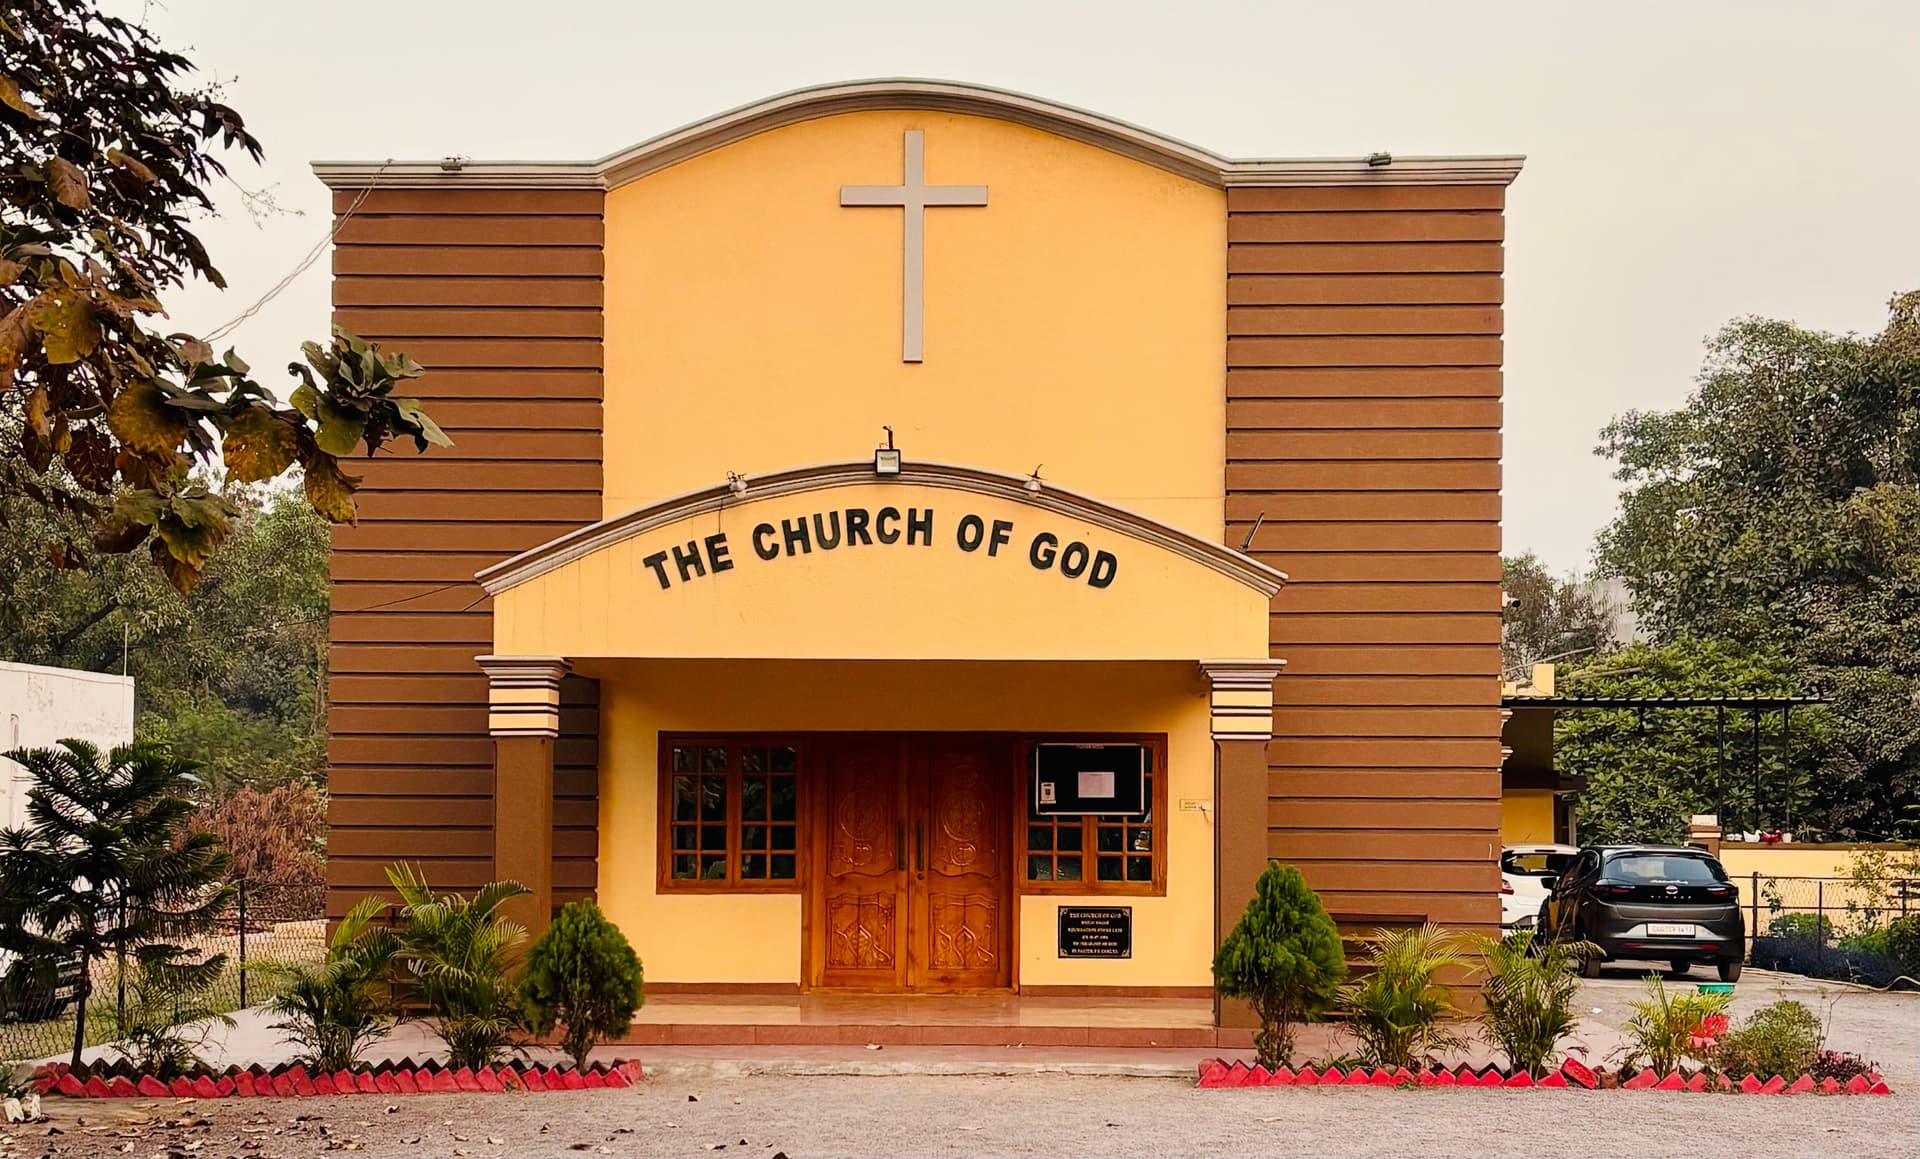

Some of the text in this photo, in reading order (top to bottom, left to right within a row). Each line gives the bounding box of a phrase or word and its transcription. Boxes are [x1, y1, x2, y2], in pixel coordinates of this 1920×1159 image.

[643, 507, 1118, 590] THE CHURCH OF GOD
